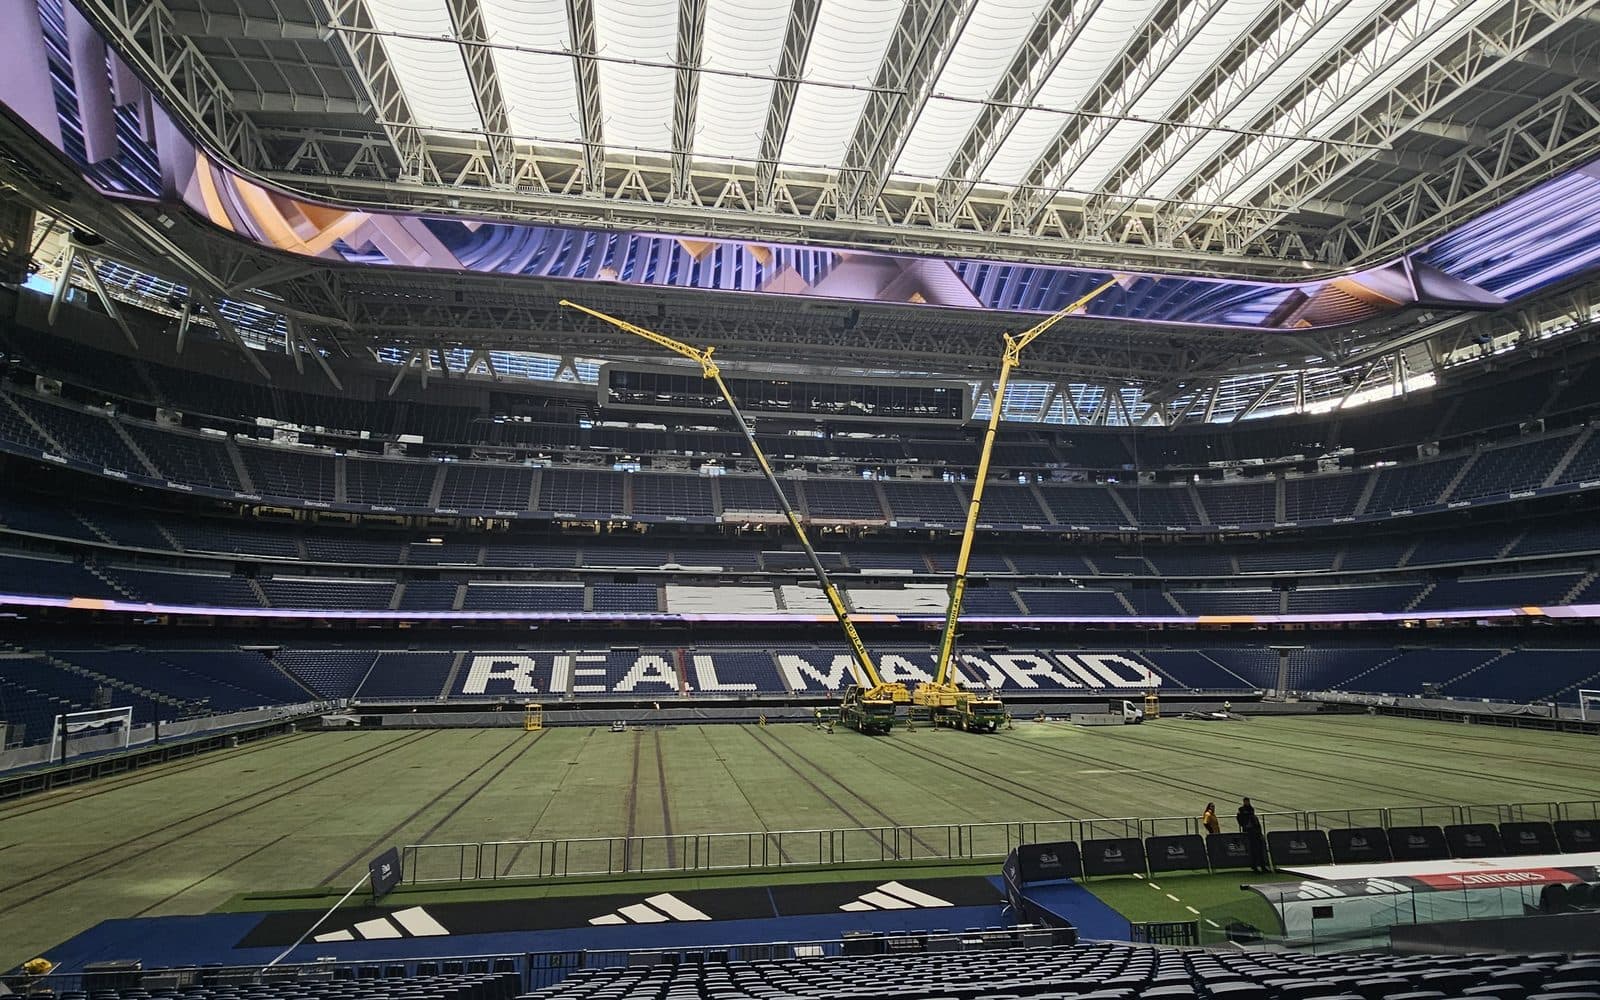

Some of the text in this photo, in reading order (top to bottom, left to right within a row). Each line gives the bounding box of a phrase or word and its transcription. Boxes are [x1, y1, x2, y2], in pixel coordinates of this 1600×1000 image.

[845, 621, 865, 654] AGUILAR
[462, 654, 1163, 694] REAL MADRID
[1447, 871, 1546, 885] Emirates
